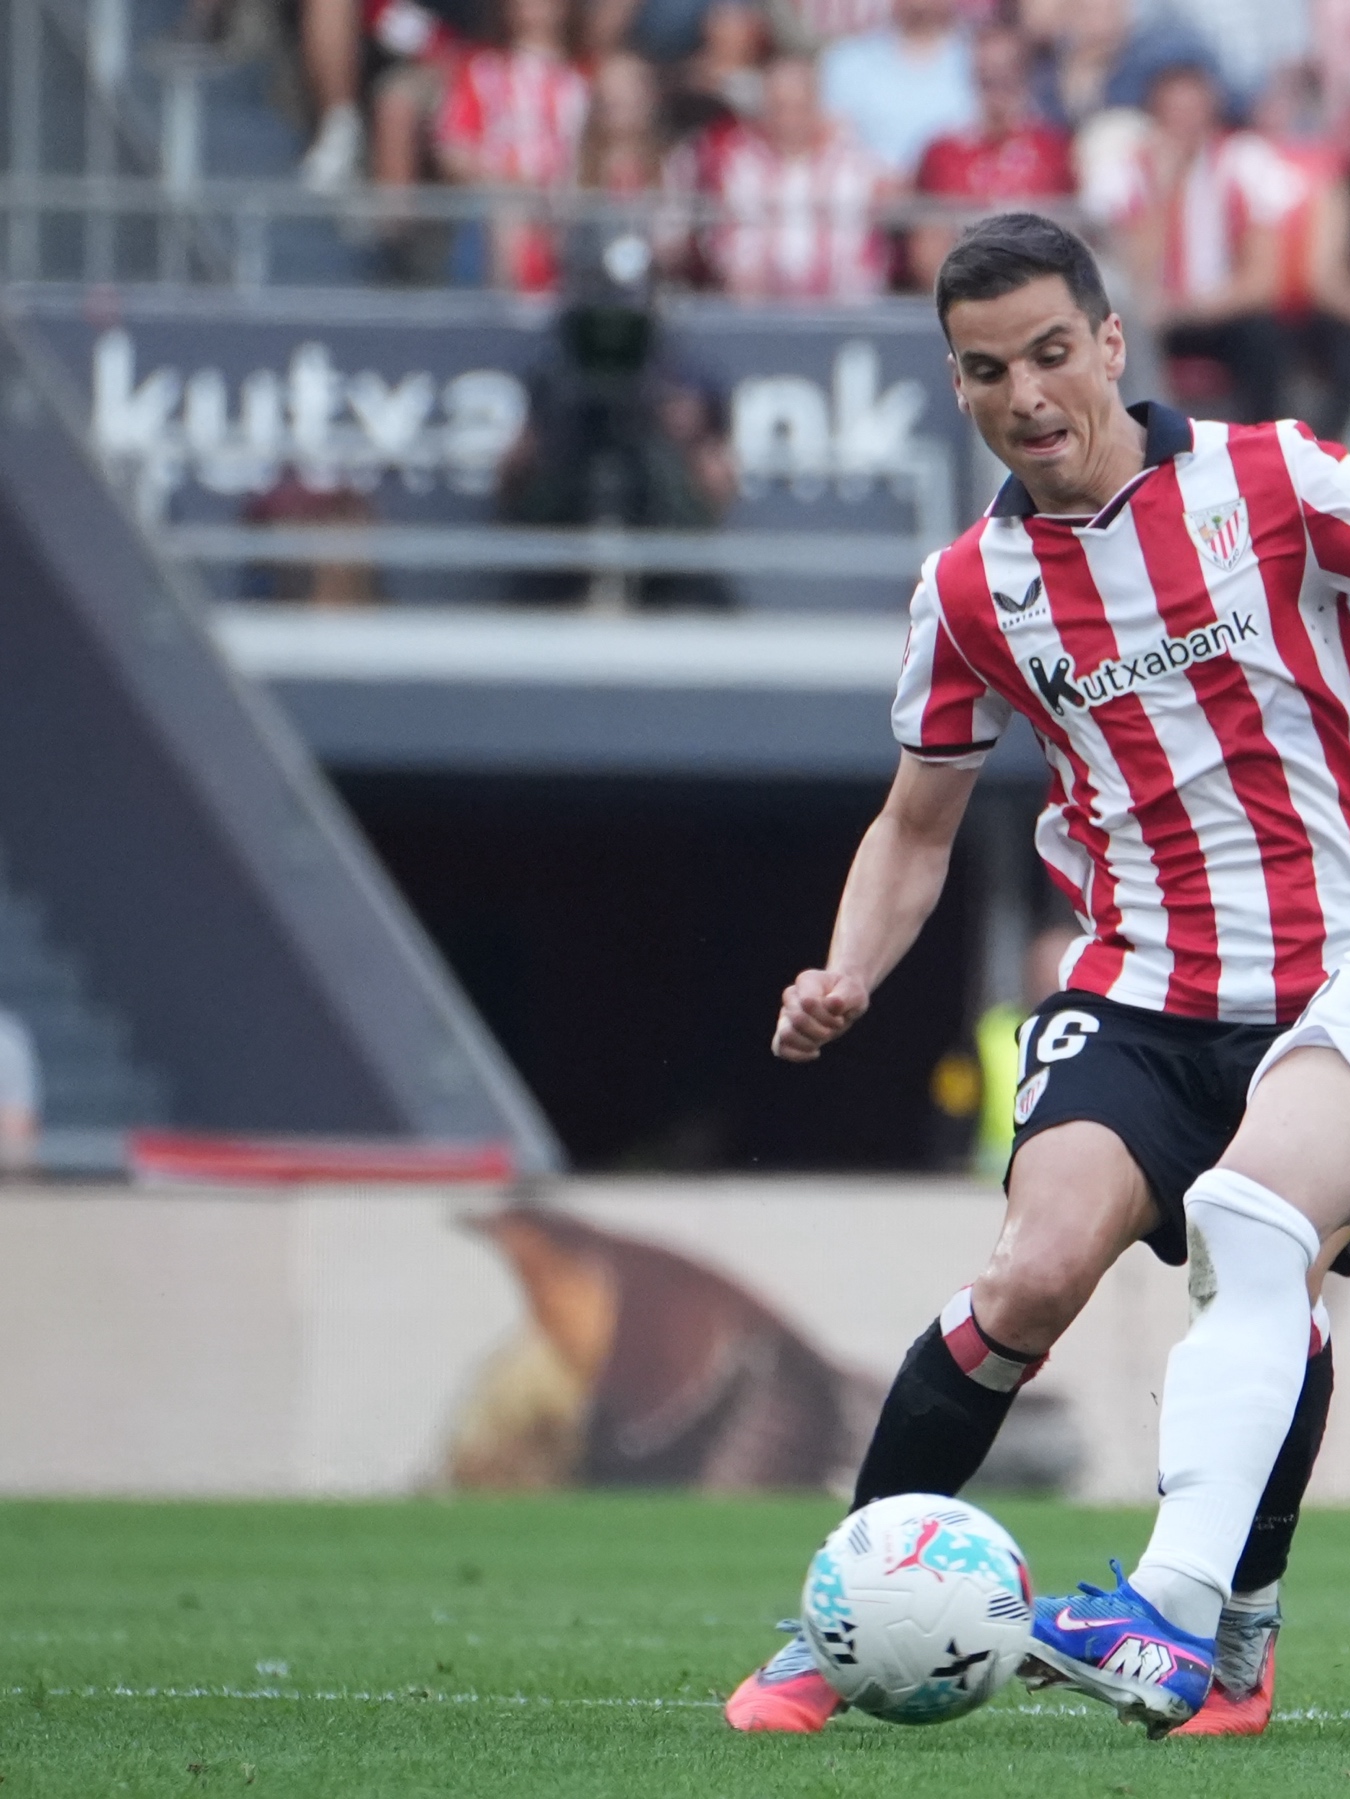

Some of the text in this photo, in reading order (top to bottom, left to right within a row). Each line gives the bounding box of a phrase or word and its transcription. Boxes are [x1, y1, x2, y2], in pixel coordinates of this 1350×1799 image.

[92, 327, 928, 500] kutxank
[1029, 611, 1259, 716] Kutxabank
[1017, 1010, 1100, 1085] 16
